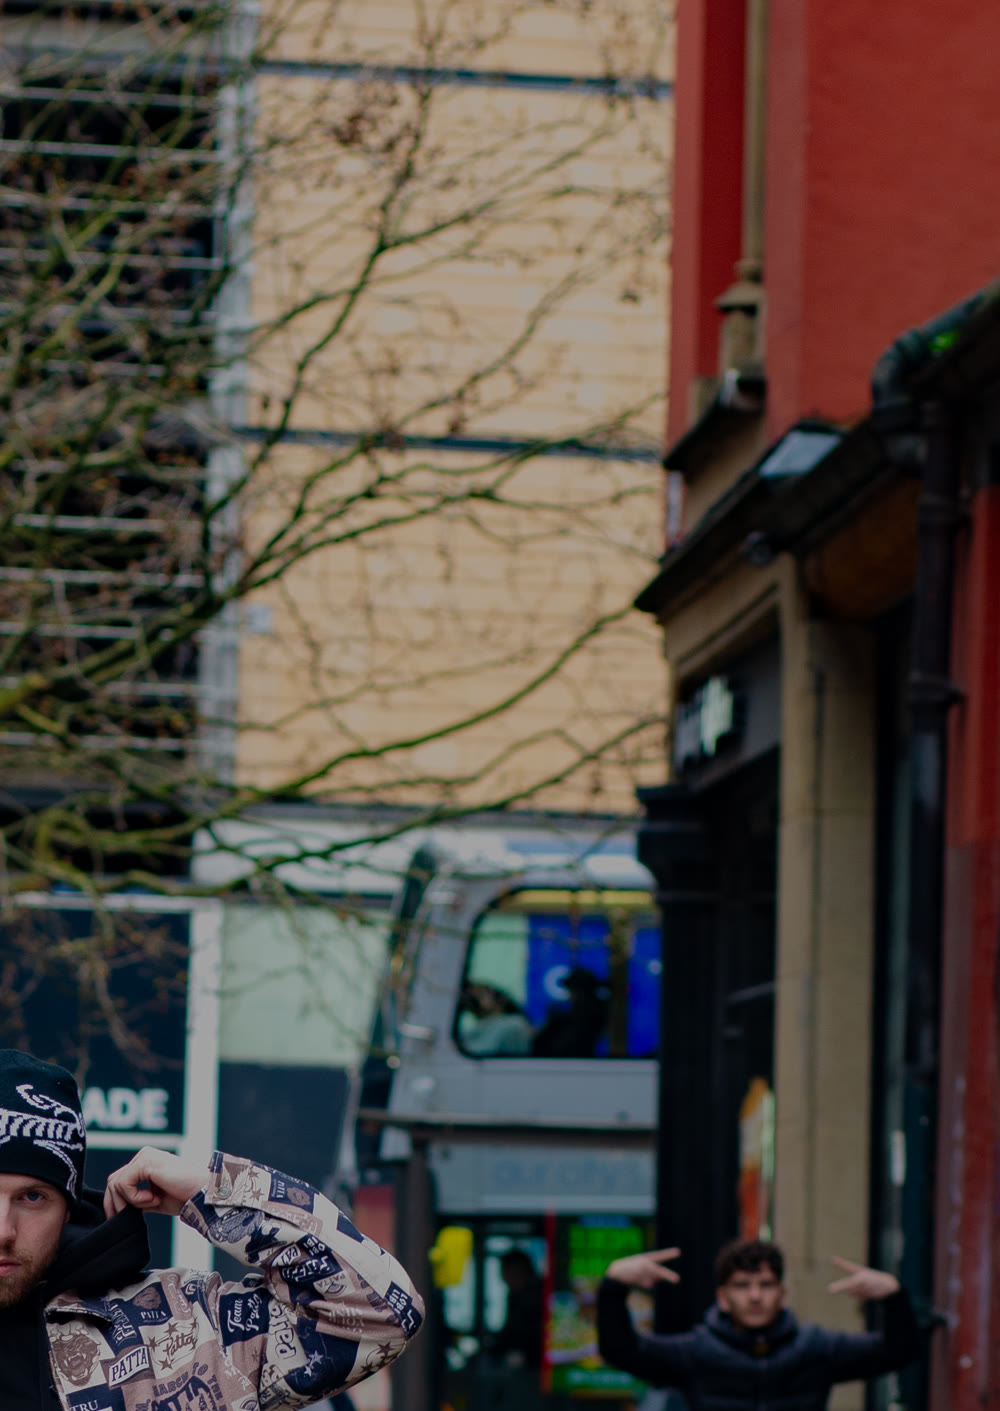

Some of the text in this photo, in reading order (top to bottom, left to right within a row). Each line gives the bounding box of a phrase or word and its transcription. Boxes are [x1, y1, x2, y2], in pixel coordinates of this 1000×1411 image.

[228, 1298, 244, 1333] Team
[163, 1333, 199, 1360] Patta
[112, 1348, 148, 1382] PATTA
